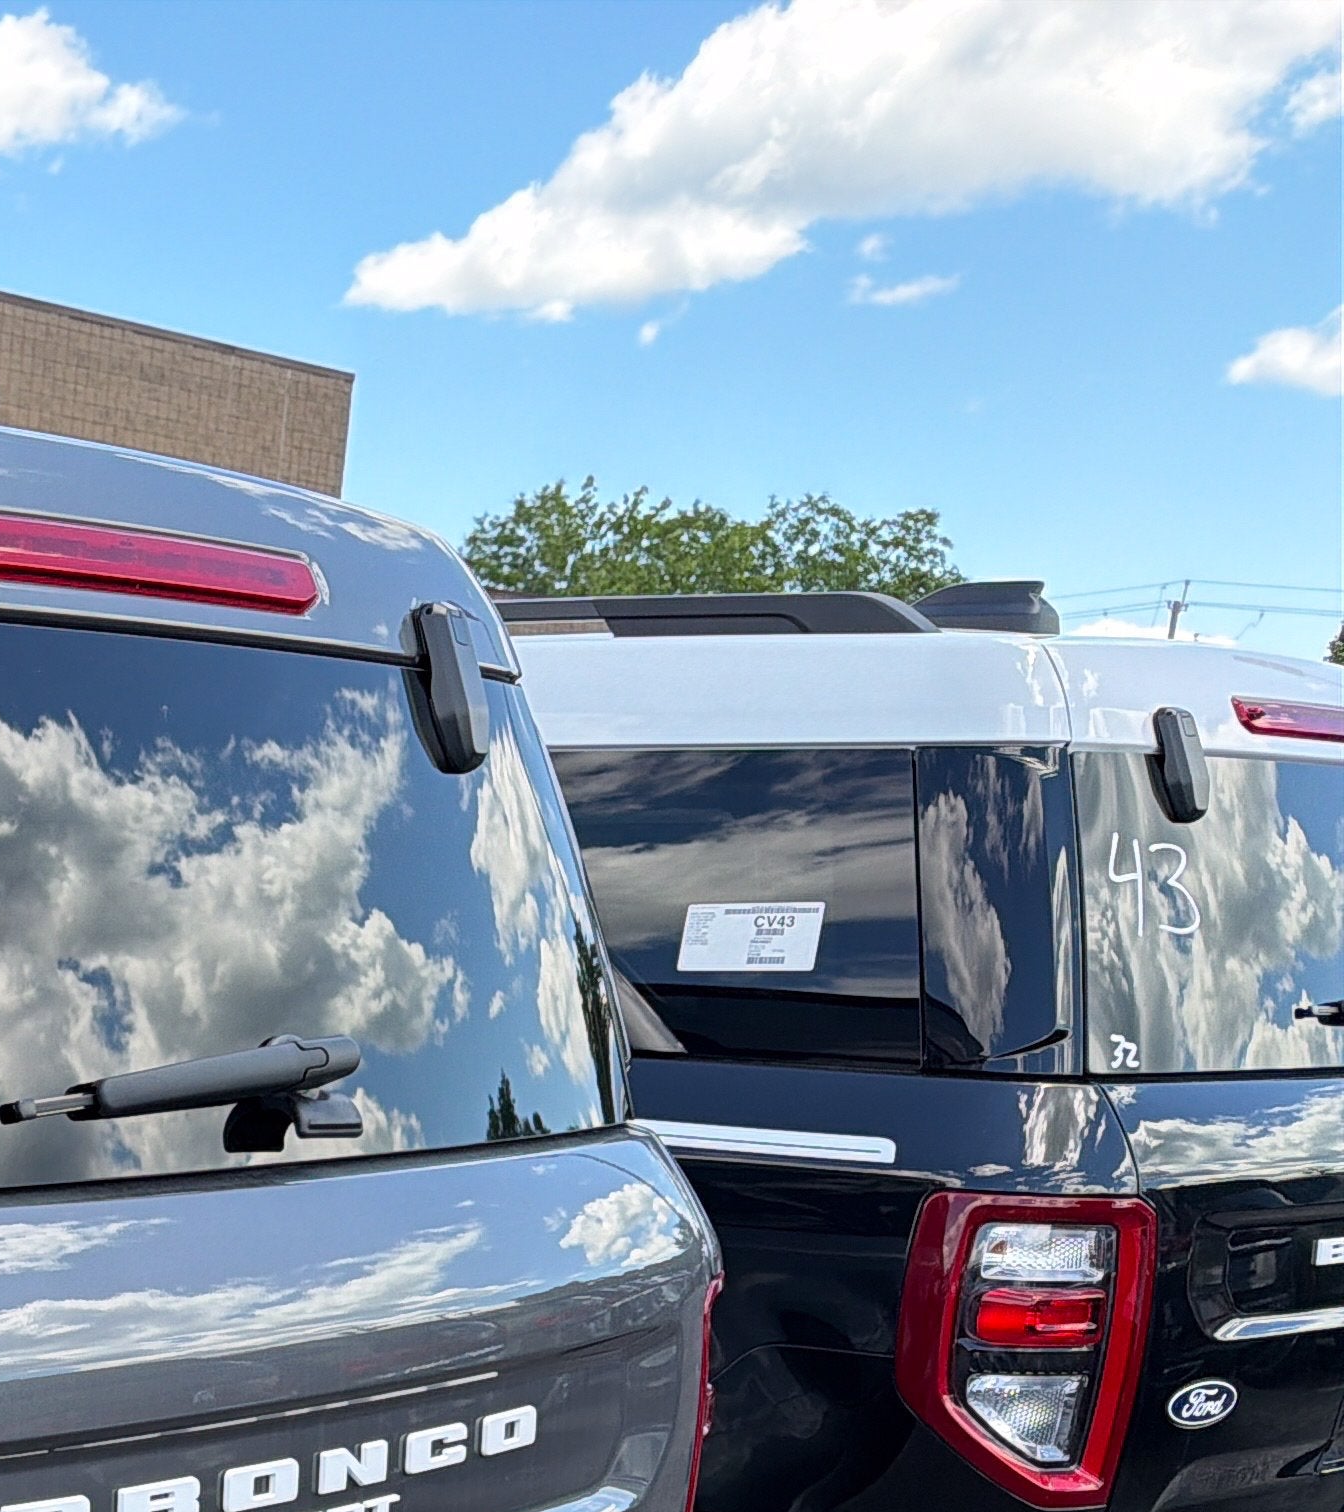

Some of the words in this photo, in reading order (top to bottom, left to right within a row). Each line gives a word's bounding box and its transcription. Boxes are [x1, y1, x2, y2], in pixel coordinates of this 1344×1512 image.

[1108, 831, 1201, 938] 43
[753, 915, 796, 928] CV43
[1110, 1033, 1140, 1069] 32
[1181, 1388, 1227, 1418] Ford
